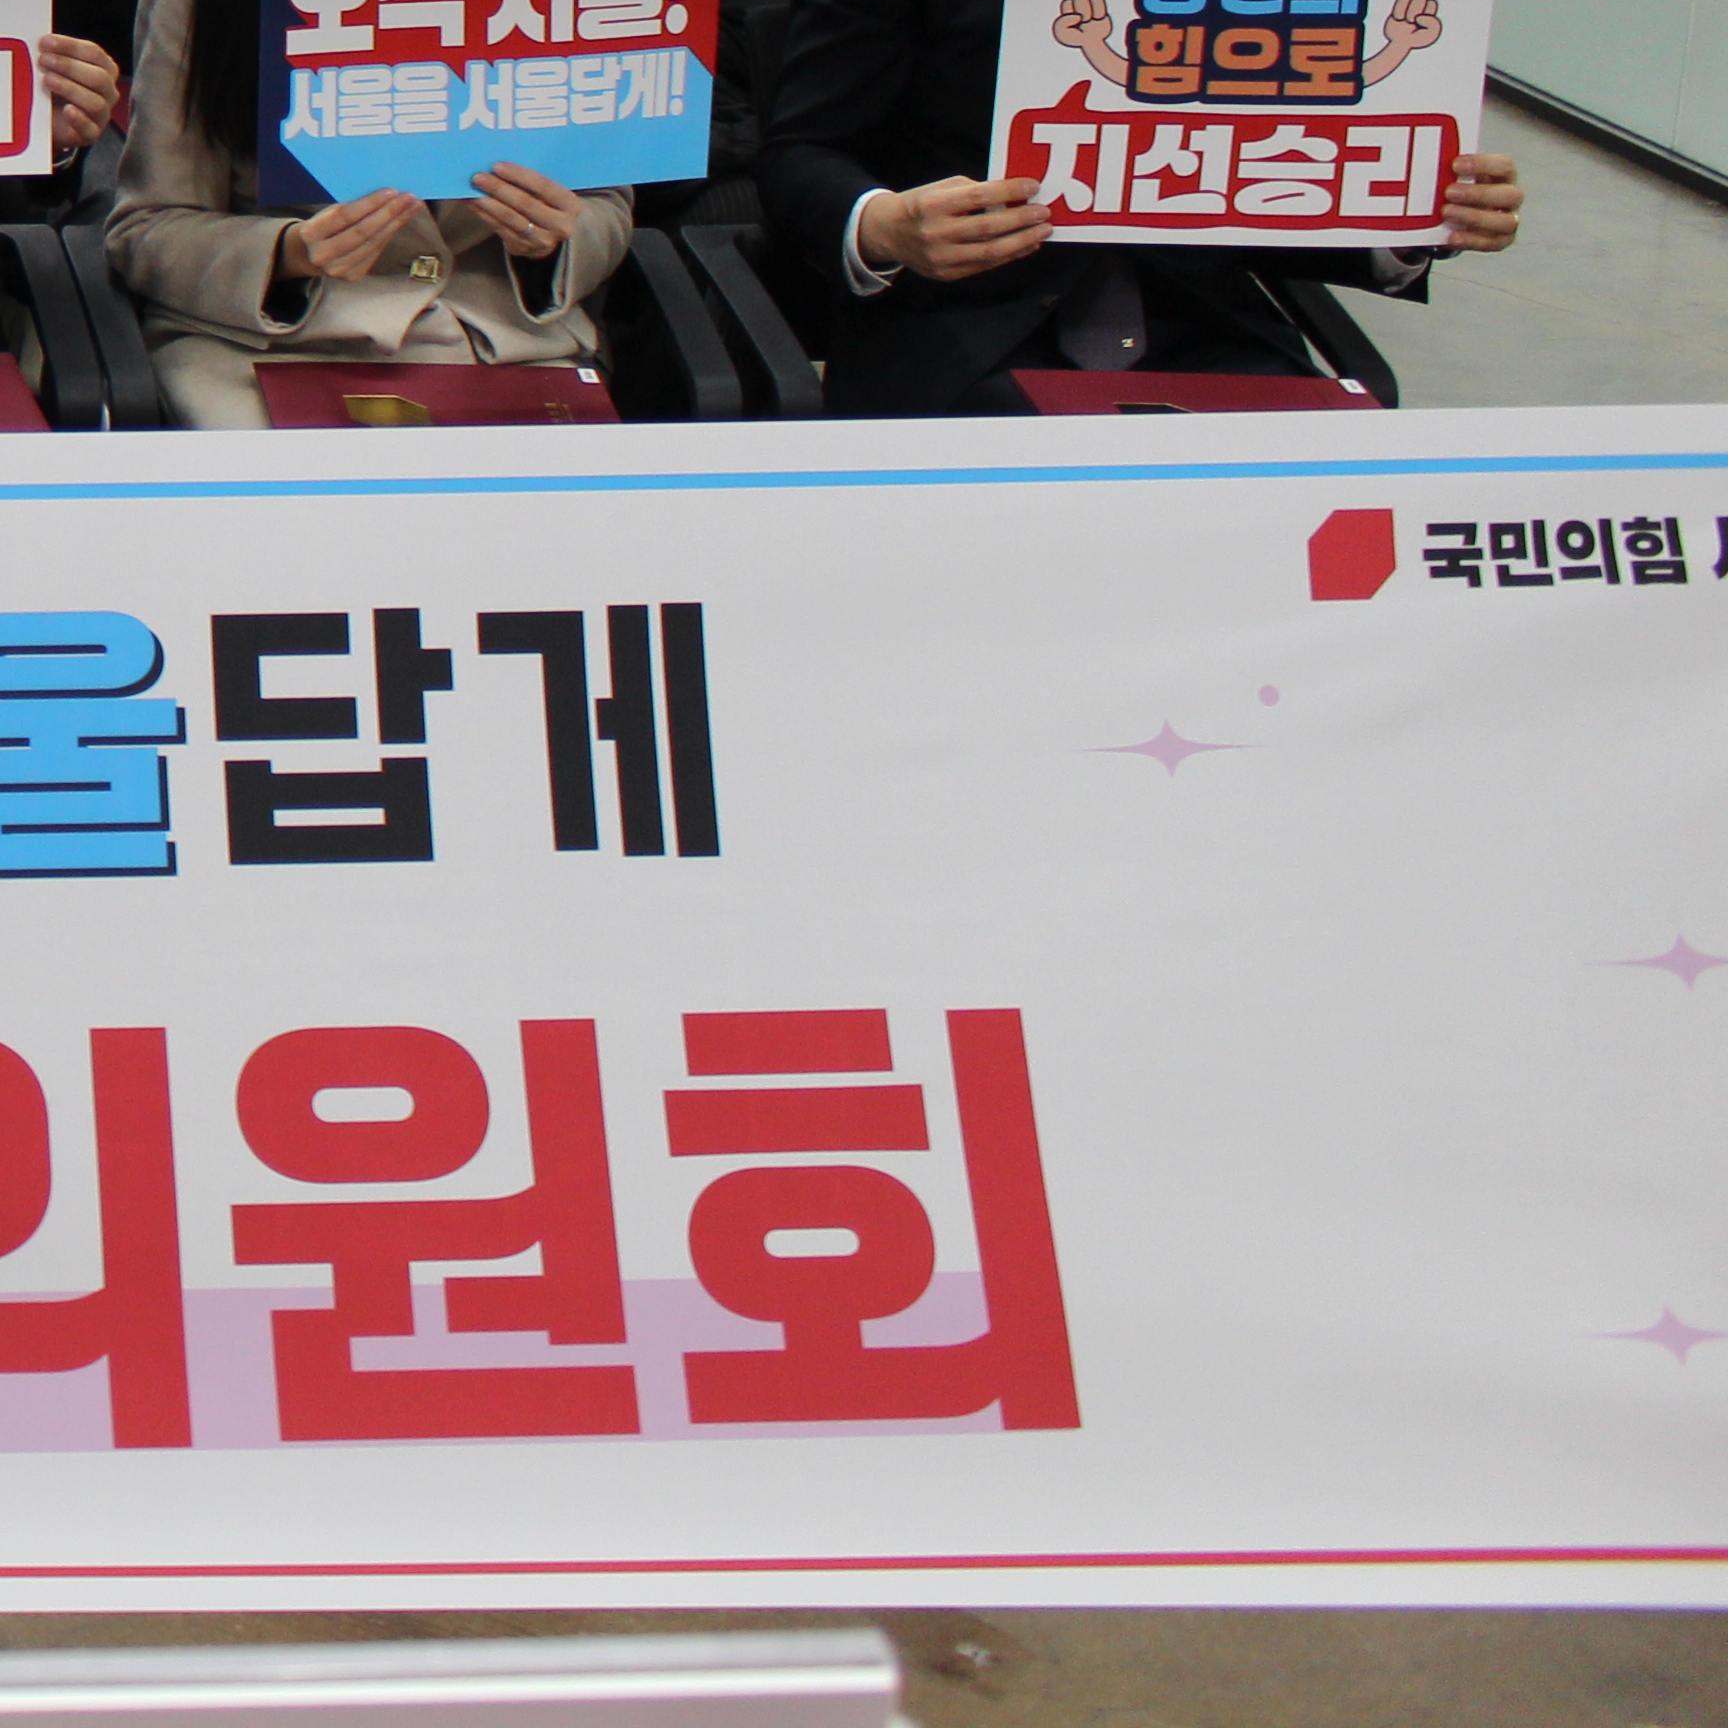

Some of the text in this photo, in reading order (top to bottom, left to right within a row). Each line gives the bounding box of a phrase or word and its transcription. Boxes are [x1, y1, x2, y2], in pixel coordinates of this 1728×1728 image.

[283, 49, 687, 140] 서울을 서울답게!
[1134, 22, 1357, 98] 힘으로
[1030, 123, 1443, 218] 지선승리
[1421, 515, 1690, 589] 국민의힘
